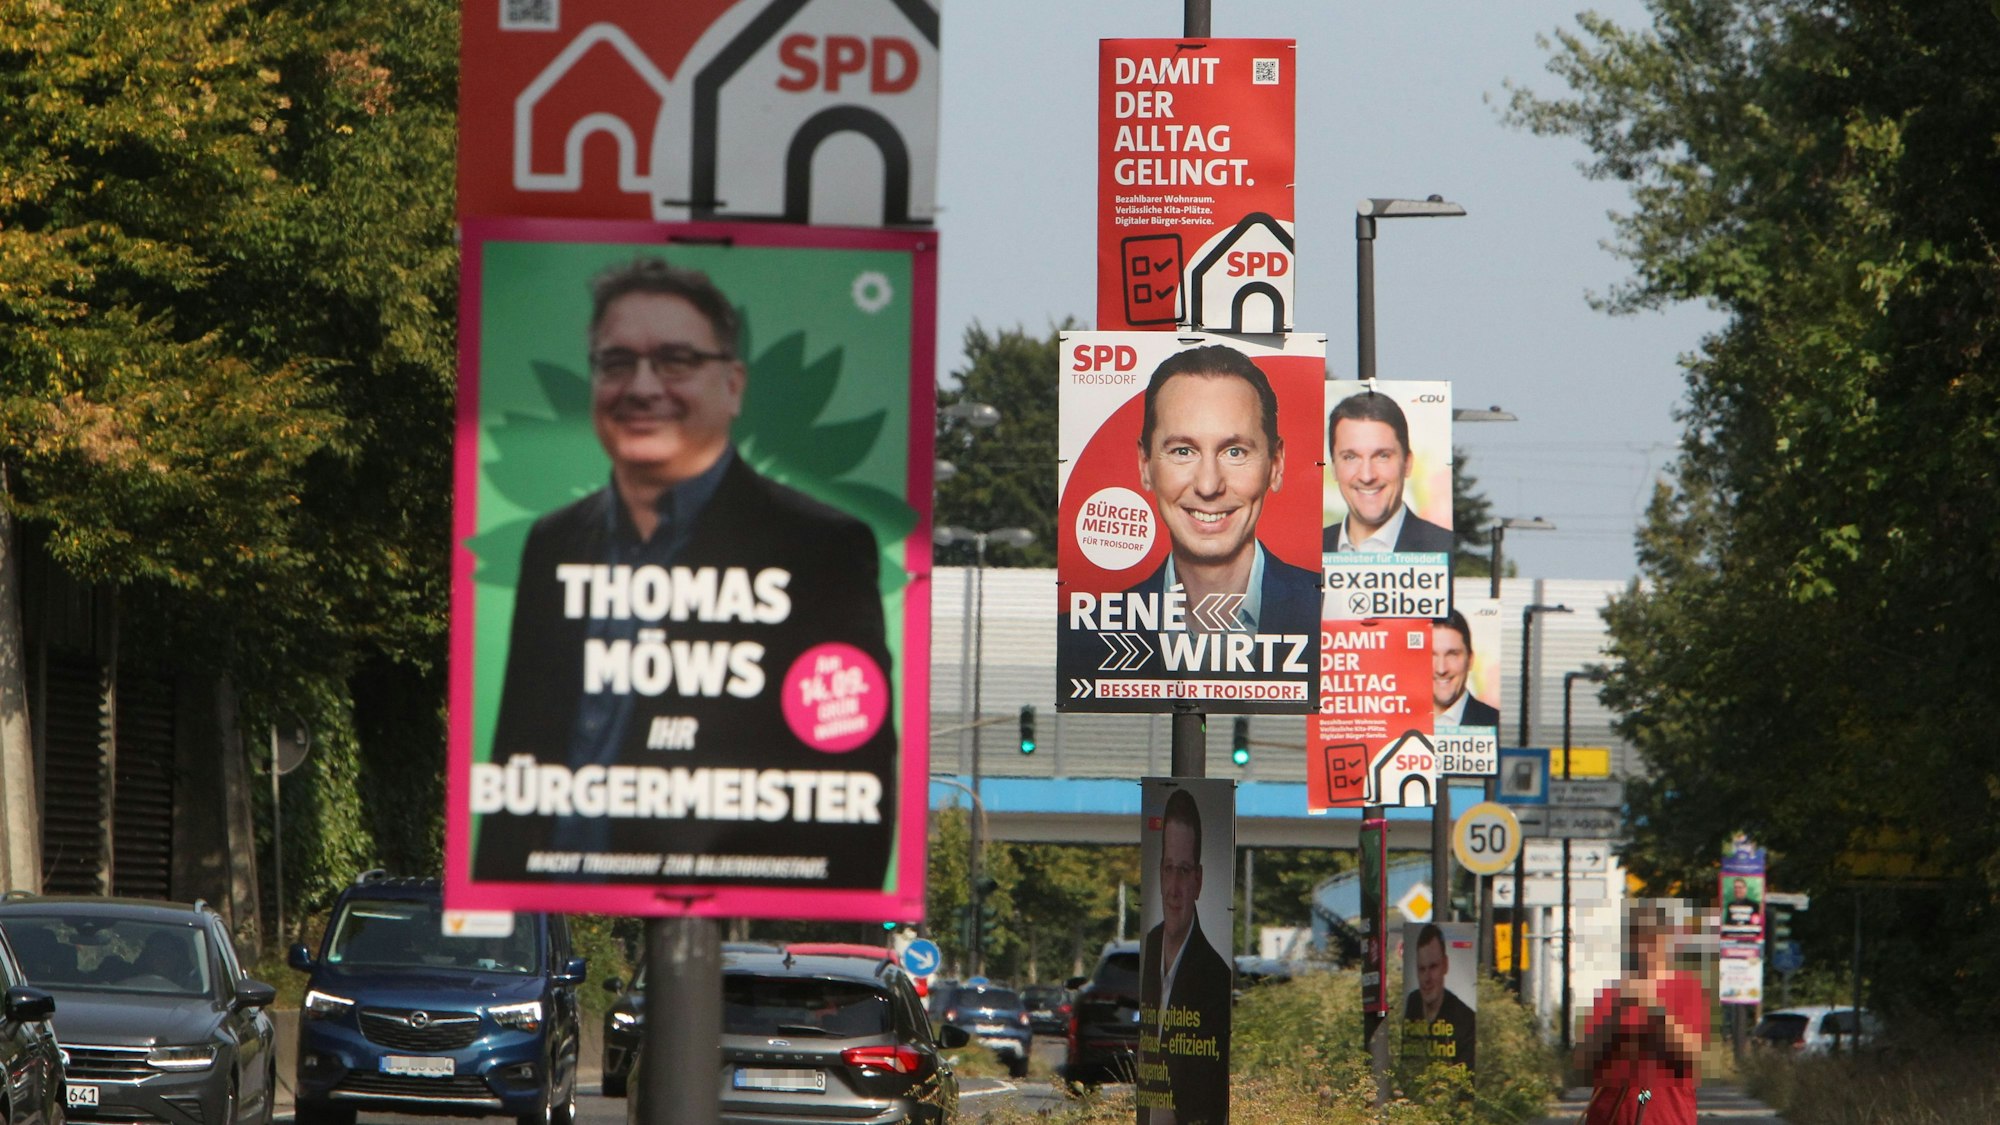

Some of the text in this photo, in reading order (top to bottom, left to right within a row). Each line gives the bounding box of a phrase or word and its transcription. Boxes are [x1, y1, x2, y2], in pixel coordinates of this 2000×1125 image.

[776, 34, 920, 95] SPD
[1115, 58, 1220, 84] DAMIT
[1115, 91, 1174, 118] DER
[1114, 125, 1230, 152] ALLTAG
[1114, 159, 1255, 187] GELINGT.
[1115, 194, 1215, 204] Bezahlbarer Wohnraum.
[1115, 206, 1212, 214] Verlässliche Kita-Plätze.
[1115, 216, 1214, 227] Digitaler Bürger-Service.
[1226, 251, 1289, 278] SPD
[1072, 344, 1138, 372] SPD
[1072, 374, 1137, 386] TROISDORF
[1419, 394, 1445, 403] CDU
[1086, 500, 1148, 523] BÜRGER
[1082, 518, 1148, 538] MEISTER
[1082, 536, 1144, 552] FÜR TROISDORF
[556, 564, 792, 624] THOMAS
[1372, 592, 1445, 615] Biber
[1070, 584, 1188, 631] RENÉ
[1321, 631, 1388, 650] DAMIT
[584, 629, 766, 698] MÖWS
[1158, 634, 1309, 672] WIRTZ
[1320, 654, 1360, 671] DER
[1100, 681, 1305, 700] BESSER FÜR TROISDORF.
[1320, 674, 1396, 692] ALLTAG
[1320, 696, 1410, 714] GELINGT.
[648, 716, 699, 750] IHR
[1436, 737, 1494, 753] ander
[1396, 754, 1432, 770] SPD
[1444, 755, 1494, 772] Biber
[470, 754, 882, 824] BÜRGERMEISTER
[1470, 824, 1506, 854] 50
[1432, 1018, 1454, 1037] die
[1169, 1032, 1220, 1061] effizient,
[69, 1088, 96, 1104] 641
